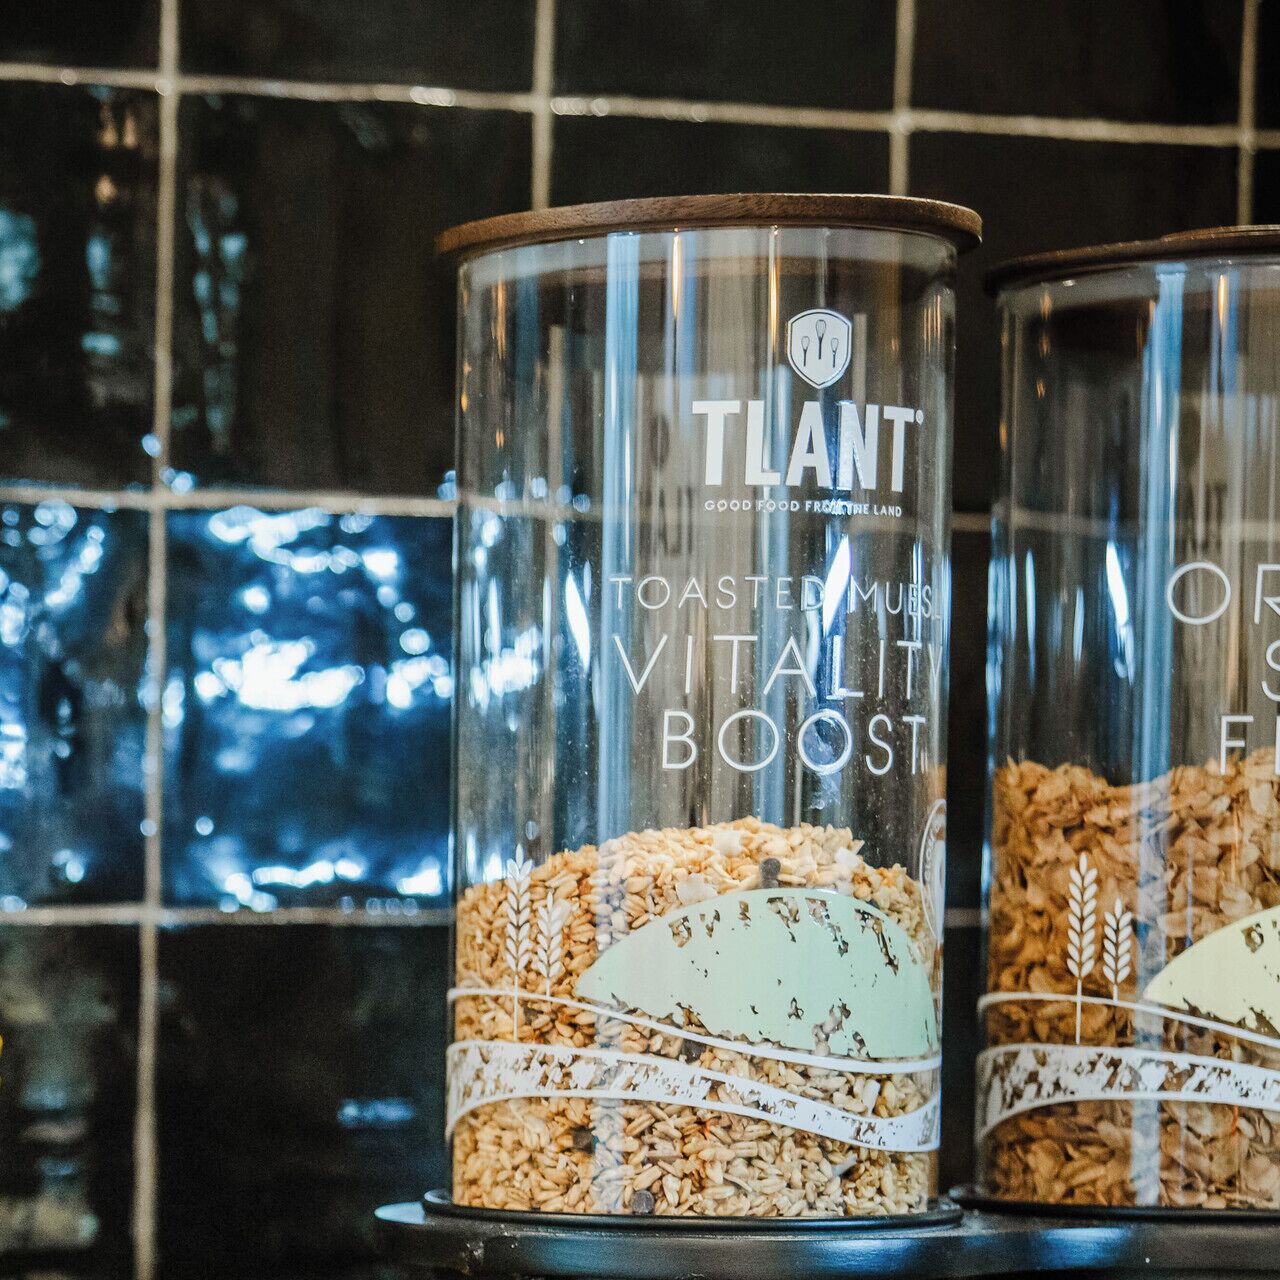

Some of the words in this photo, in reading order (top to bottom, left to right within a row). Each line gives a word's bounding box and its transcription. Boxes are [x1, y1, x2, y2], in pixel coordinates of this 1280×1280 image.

[704, 500, 751, 513] GOOD
[756, 500, 801, 513] FOOD
[873, 503, 902, 518] LAND
[609, 575, 826, 612] TOASTED
[662, 708, 927, 776] BOOST
